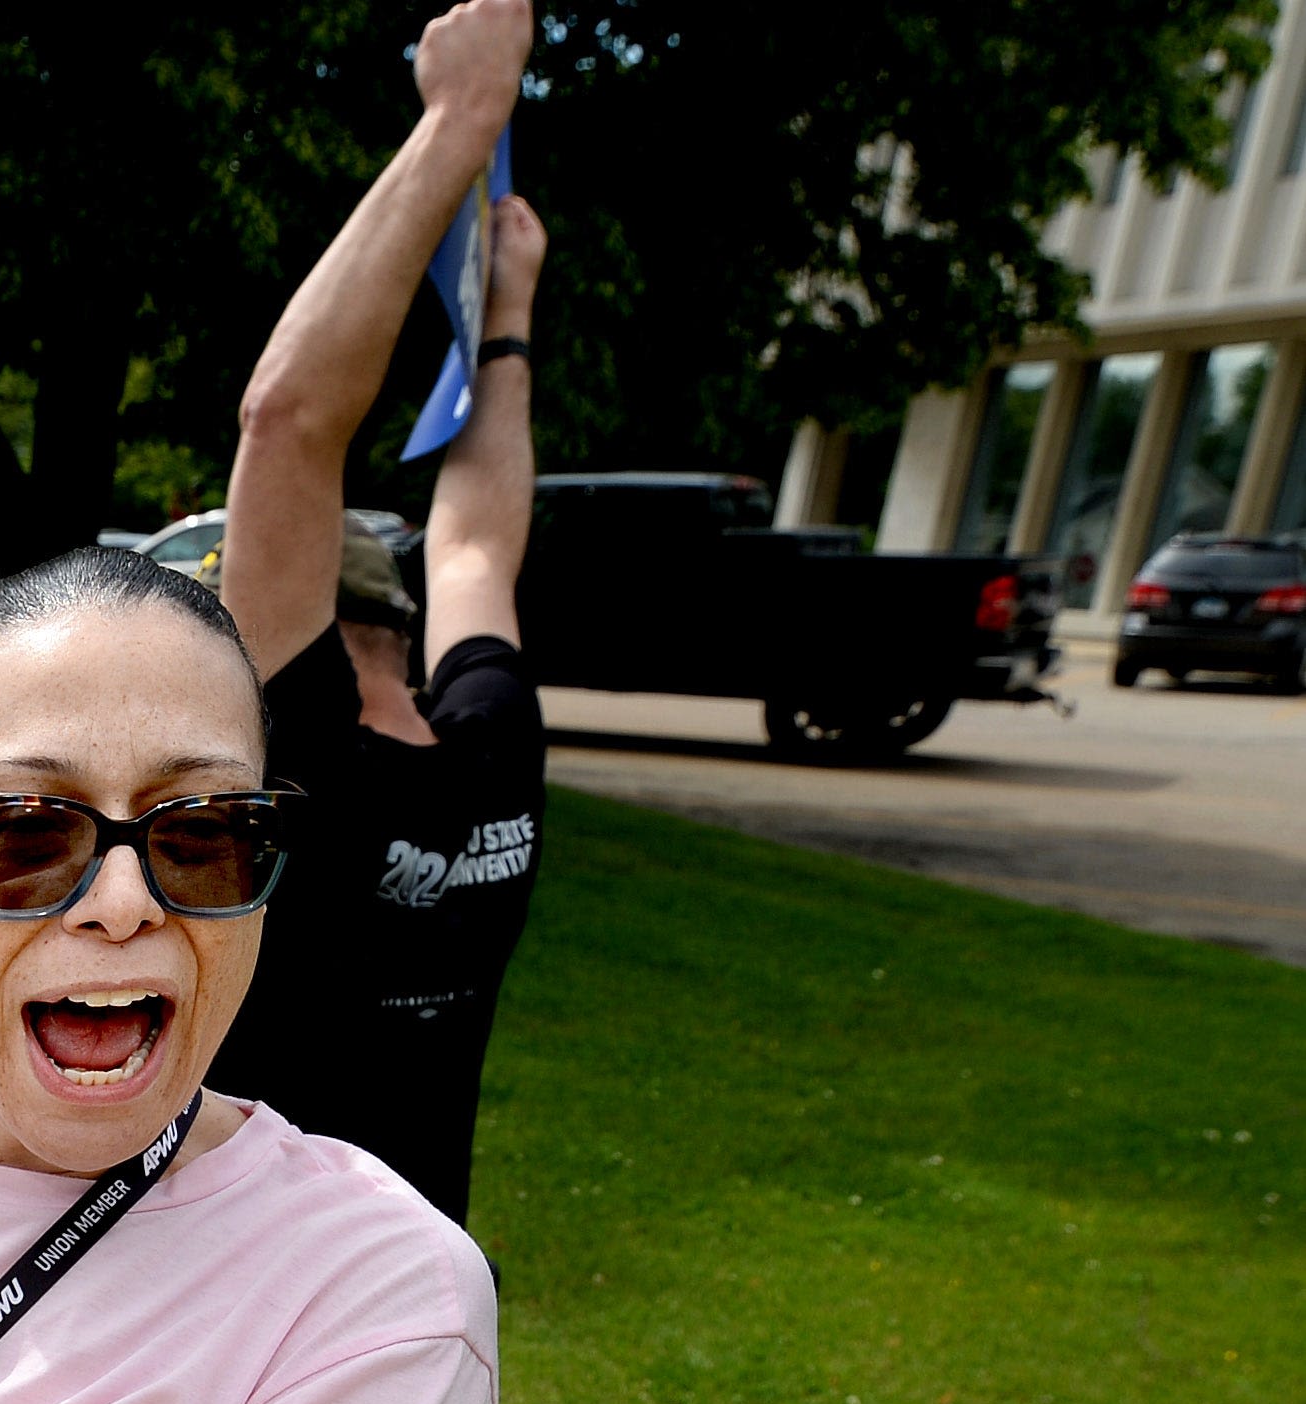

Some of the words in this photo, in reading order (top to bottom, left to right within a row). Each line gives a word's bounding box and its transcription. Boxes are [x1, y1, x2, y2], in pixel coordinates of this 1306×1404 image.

[34, 1228, 81, 1272] UNION
[74, 1179, 131, 1233] MEMBER
[142, 1119, 178, 1176] APWU
